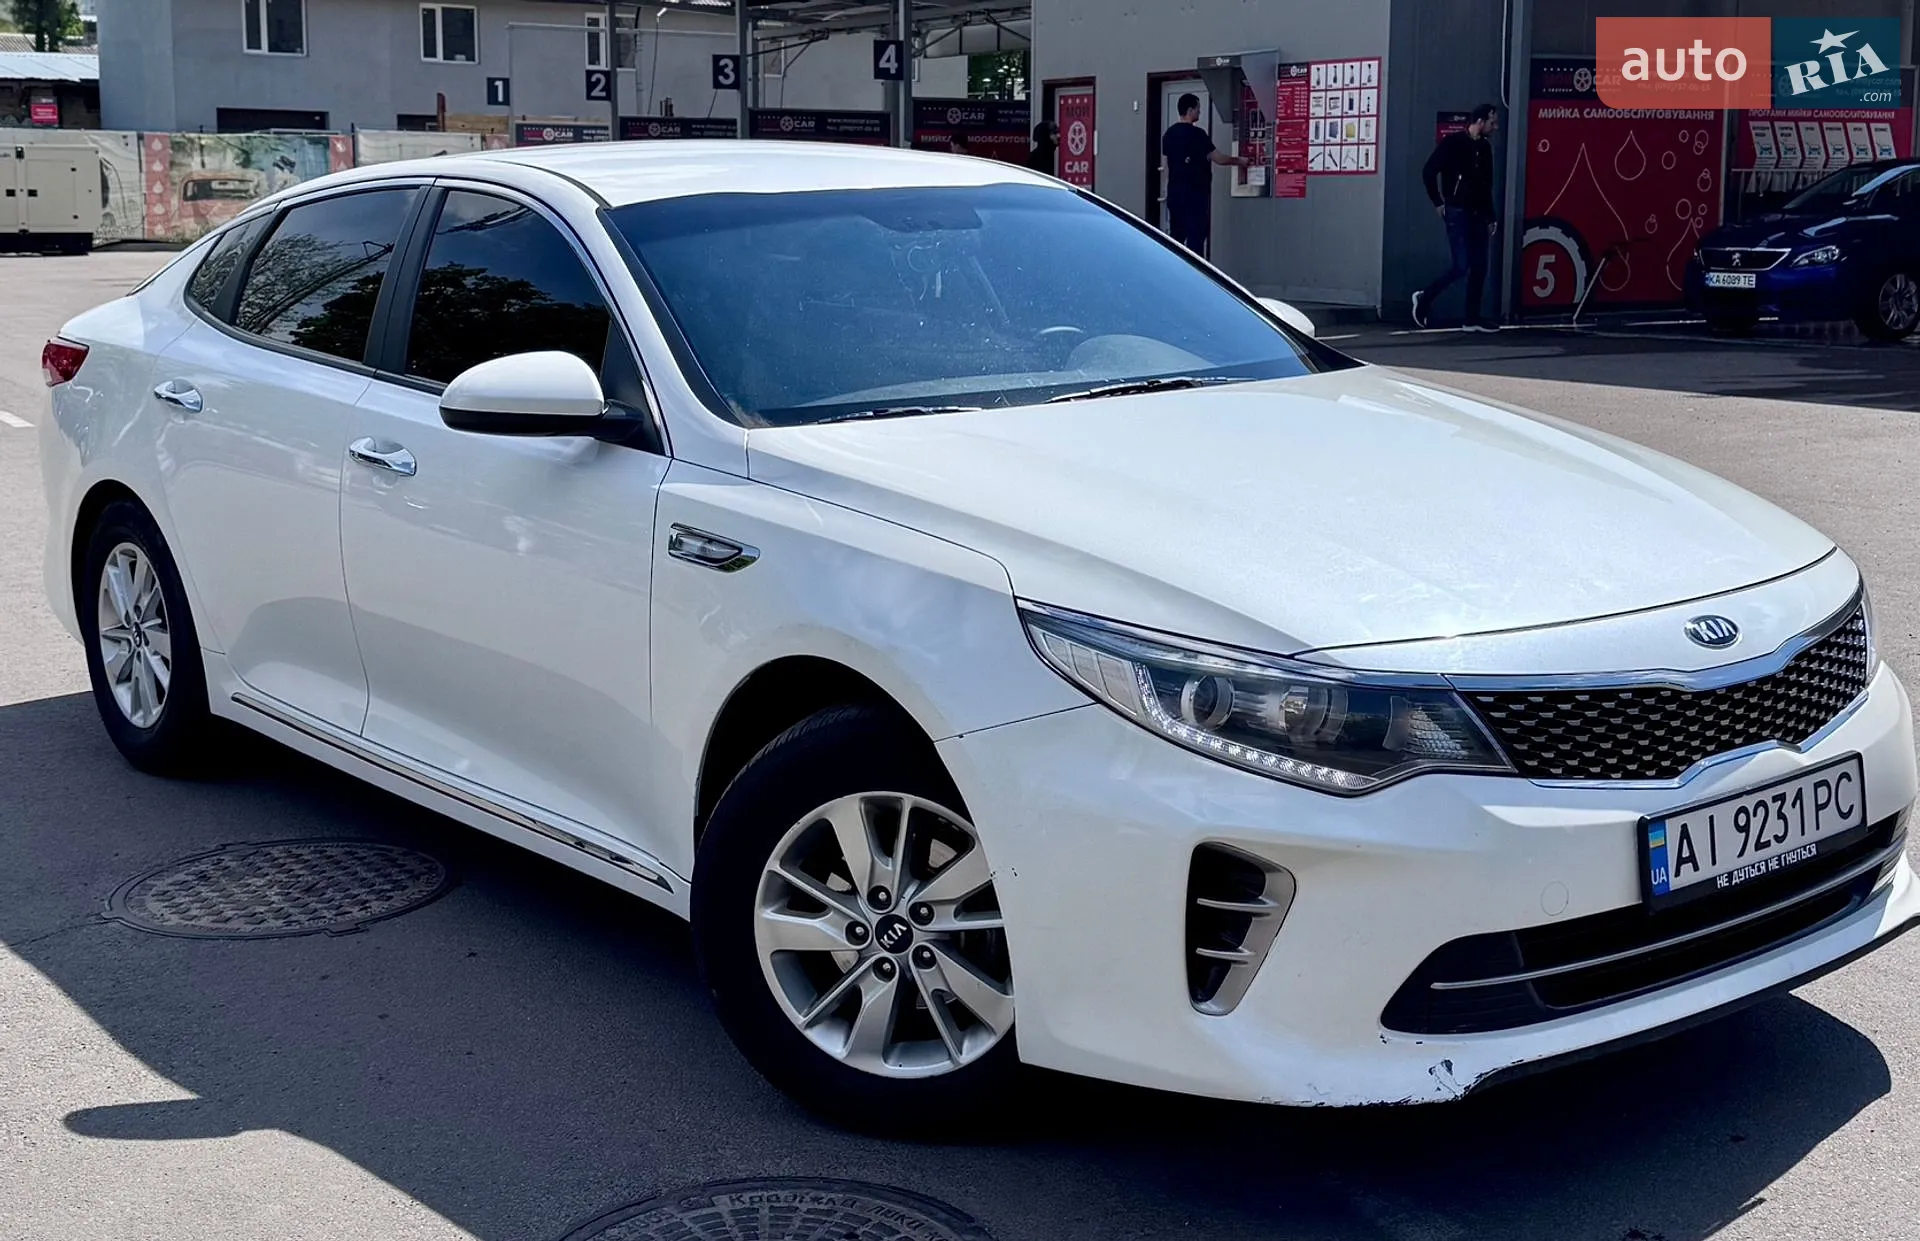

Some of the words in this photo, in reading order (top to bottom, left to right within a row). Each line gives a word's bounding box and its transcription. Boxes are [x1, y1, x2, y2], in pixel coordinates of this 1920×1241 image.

[718, 58, 736, 85] 3
[878, 44, 898, 74] 4
[494, 81, 504, 102] 1
[590, 73, 607, 98] 2
[1538, 106, 1580, 119] МИЙКА
[1583, 108, 1715, 121] САМООБСЛУГОВУВАННЯ
[1064, 161, 1089, 173] CAR
[1533, 254, 1556, 297] 5
[1694, 618, 1737, 643] KIA
[1674, 814, 1717, 877] AI
[1733, 787, 1807, 859] 9231
[1813, 771, 1855, 831] PC
[1651, 868, 1667, 887] UA
[1716, 873, 1730, 889] НЕ
[1732, 861, 1767, 884] ДУТЬСЯ
[1767, 856, 1781, 872] НЕ
[1781, 843, 1817, 868] ГНУТЬСЯ
[880, 922, 908, 948] KIA
